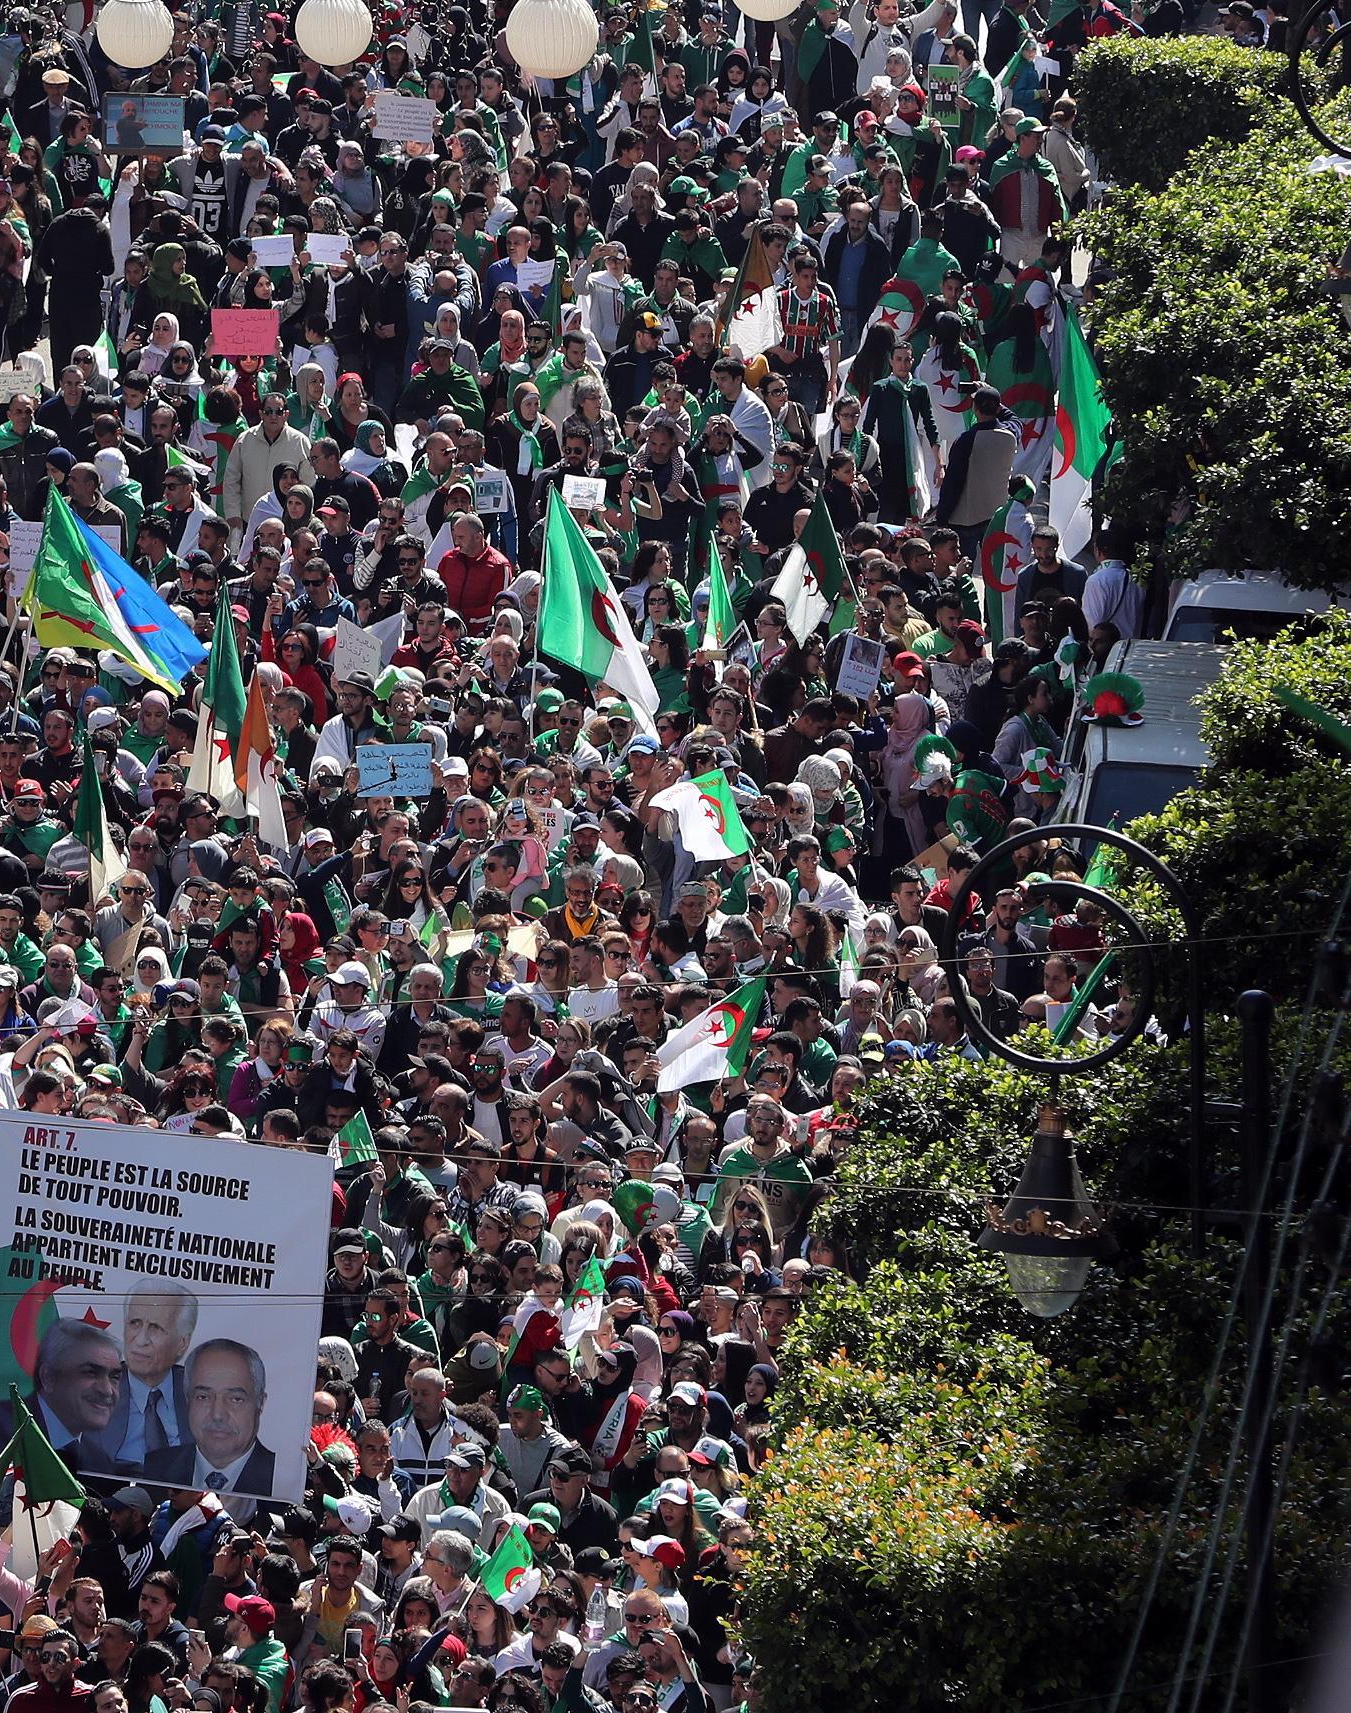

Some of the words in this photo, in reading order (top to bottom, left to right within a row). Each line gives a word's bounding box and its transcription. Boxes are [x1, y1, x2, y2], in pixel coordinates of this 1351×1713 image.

[23, 1126, 60, 1150] ART.
[65, 1131, 79, 1152] 7.
[631, 1138, 649, 1148] NYC
[18, 1173, 41, 1196] DE
[45, 1177, 94, 1205] TOUT
[96, 1186, 184, 1219] POUVOIR.
[21, 1149, 40, 1171] LE
[43, 1153, 112, 1182] PEUPLE
[114, 1162, 149, 1186] EST
[151, 1167, 173, 1190] LA
[176, 1171, 251, 1201] SOURCE
[14, 1206, 37, 1229] LA
[40, 1208, 176, 1251] SOUVERAINETÉ
[177, 1231, 277, 1265] NATIONALE
[7, 1257, 35, 1280] AU
[37, 1261, 107, 1293] PEUPLE.
[10, 1231, 123, 1269] APPARTIENT
[124, 1250, 276, 1290] EXCLUSIVEMENT
